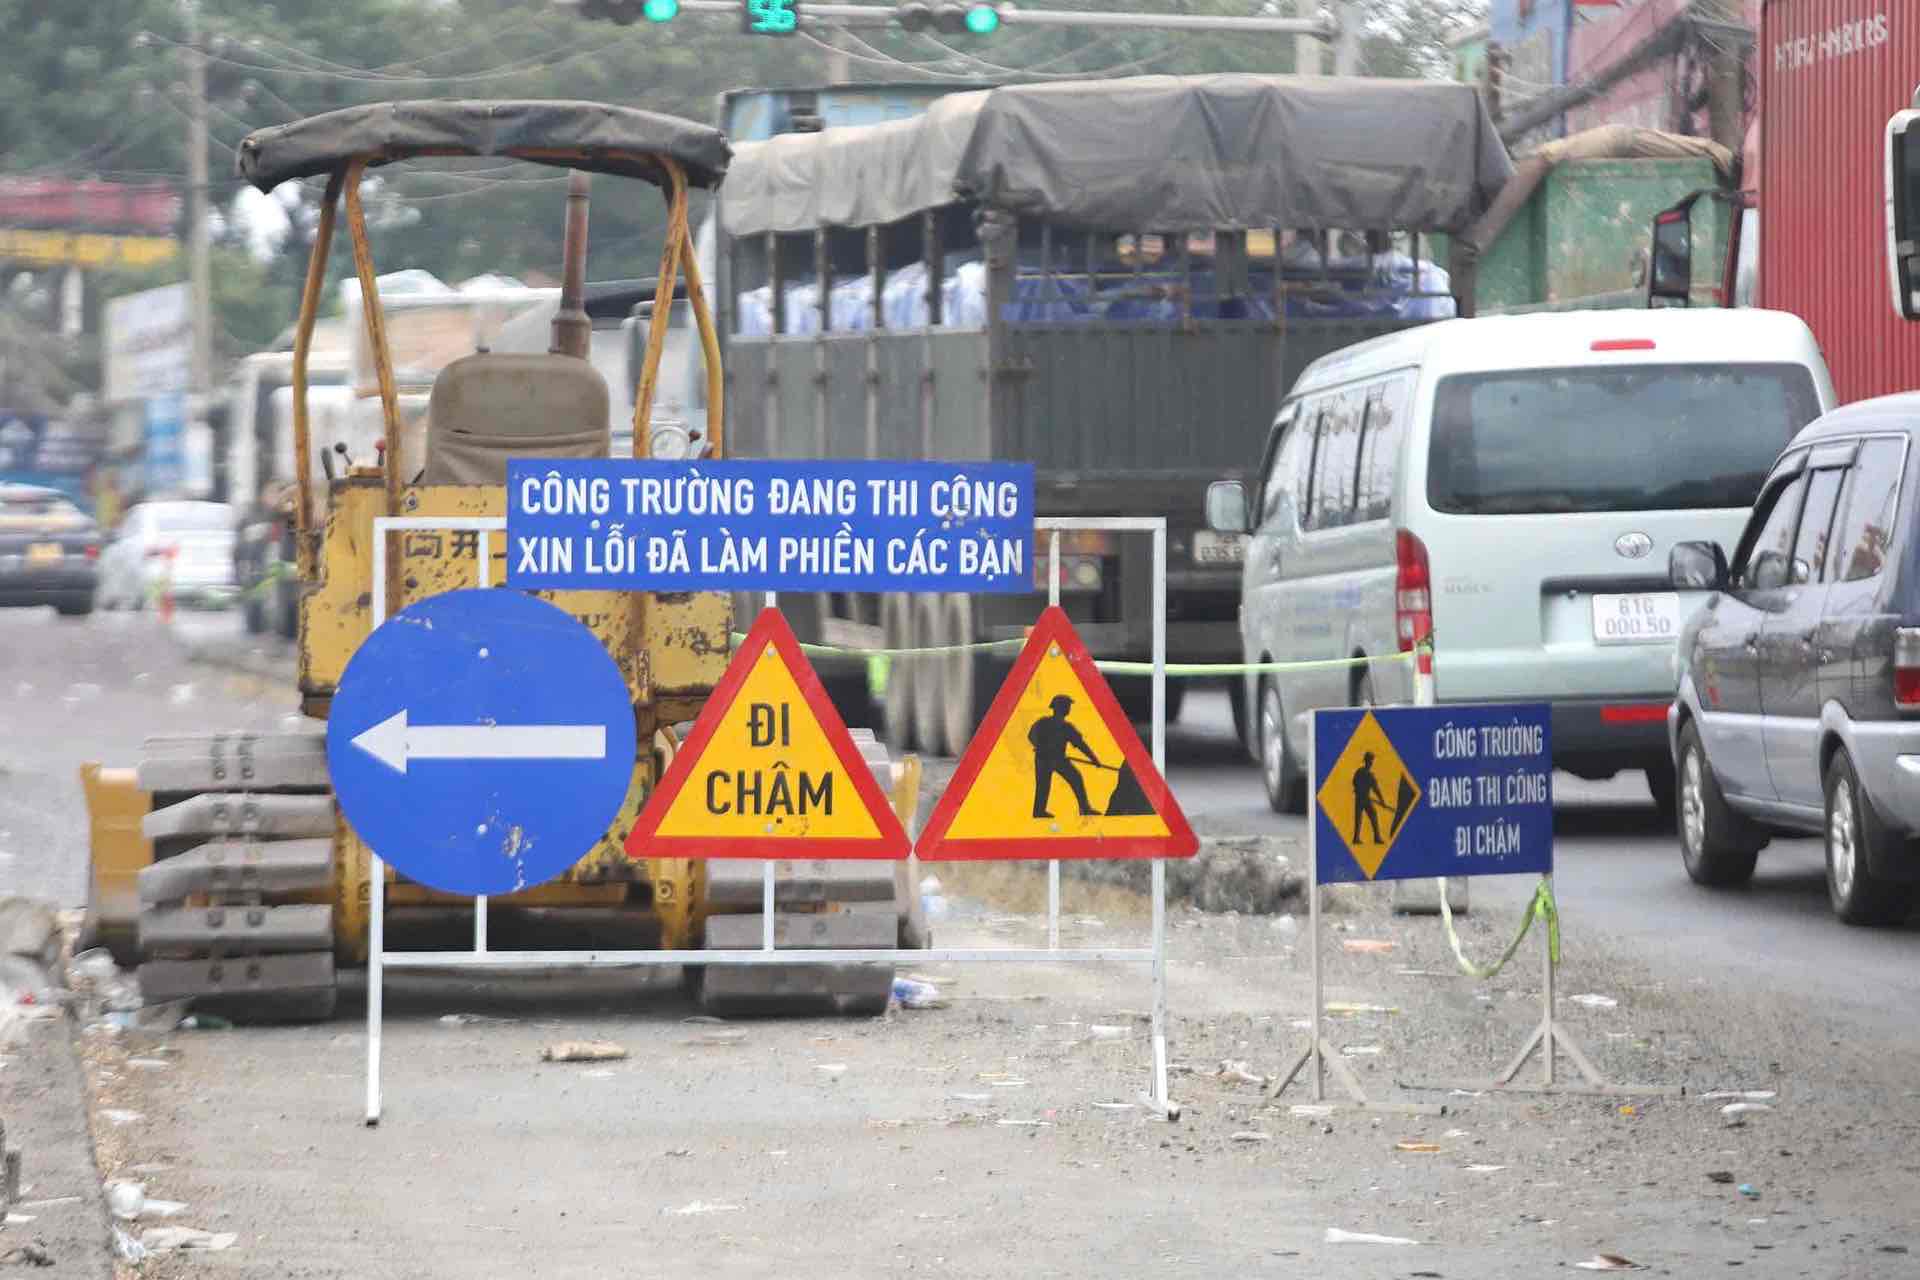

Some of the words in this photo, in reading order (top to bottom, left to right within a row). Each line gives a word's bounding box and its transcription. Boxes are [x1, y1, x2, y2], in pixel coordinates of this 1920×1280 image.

[522, 470, 610, 515] CÔNG
[621, 467, 755, 515] TRƯỜNG
[768, 478, 857, 515] ĐANG
[867, 479, 918, 516] THI
[517, 536, 573, 573] XIN
[585, 523, 636, 574] LỖI
[645, 529, 690, 574] ĐÃ
[700, 527, 768, 574] LÀM
[779, 521, 875, 575] PHIỀN
[887, 528, 949, 575] CÁC
[959, 537, 1023, 581] BẠN
[746, 702, 790, 747] ĐI
[1434, 721, 1476, 759] CÔNG
[1481, 716, 1544, 757] TRƯỜNG
[706, 760, 833, 824] CHẬM
[1428, 775, 1472, 809] ĐANG
[1476, 775, 1501, 806] THI
[1506, 768, 1547, 805] CÔNG
[1455, 825, 1471, 857] ĐI
[1476, 816, 1521, 862] CHẬM
